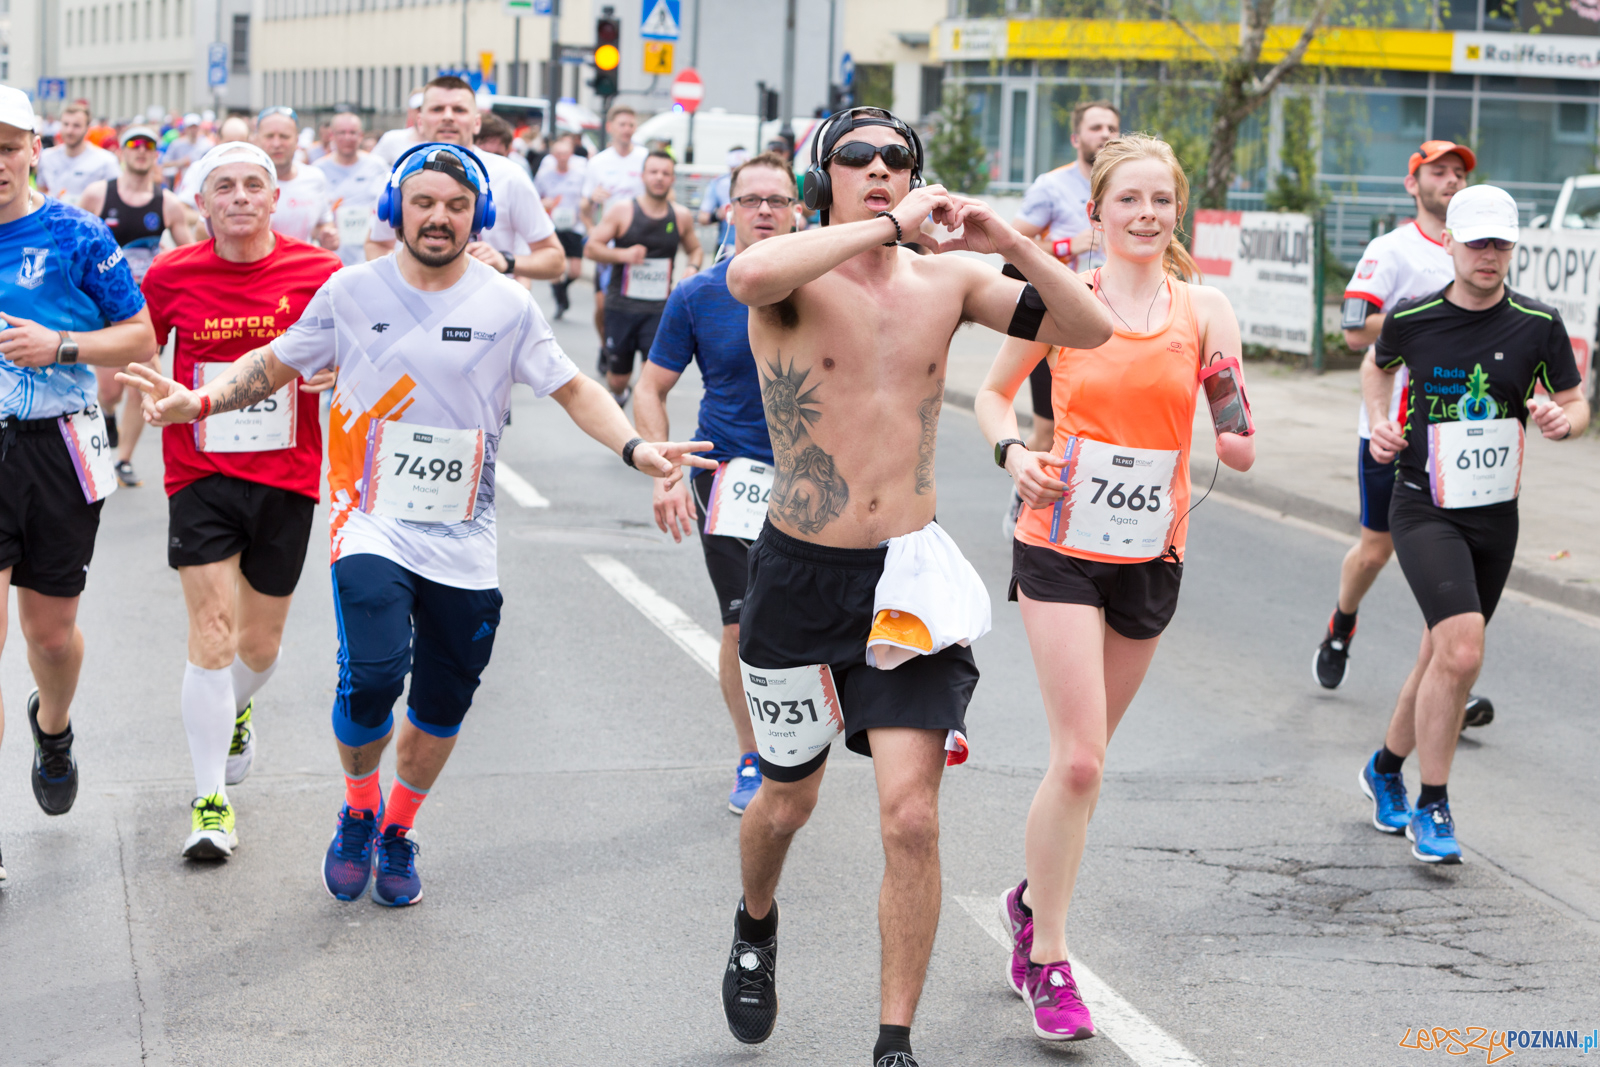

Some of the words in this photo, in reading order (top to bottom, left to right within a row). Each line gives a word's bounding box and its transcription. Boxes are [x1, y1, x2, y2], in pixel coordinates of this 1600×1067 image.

[204, 316, 275, 330] MOTOR
[371, 322, 390, 333] 4F
[1433, 366, 1466, 379] Rada
[1423, 381, 1467, 395] Osiedla
[1456, 446, 1510, 470] 6107
[394, 452, 463, 483] 7498
[412, 485, 439, 495] Maciej
[1090, 476, 1162, 513] 7665
[1109, 514, 1138, 526] Agata
[745, 690, 819, 725] 11931
[768, 728, 797, 738] Jarrett
